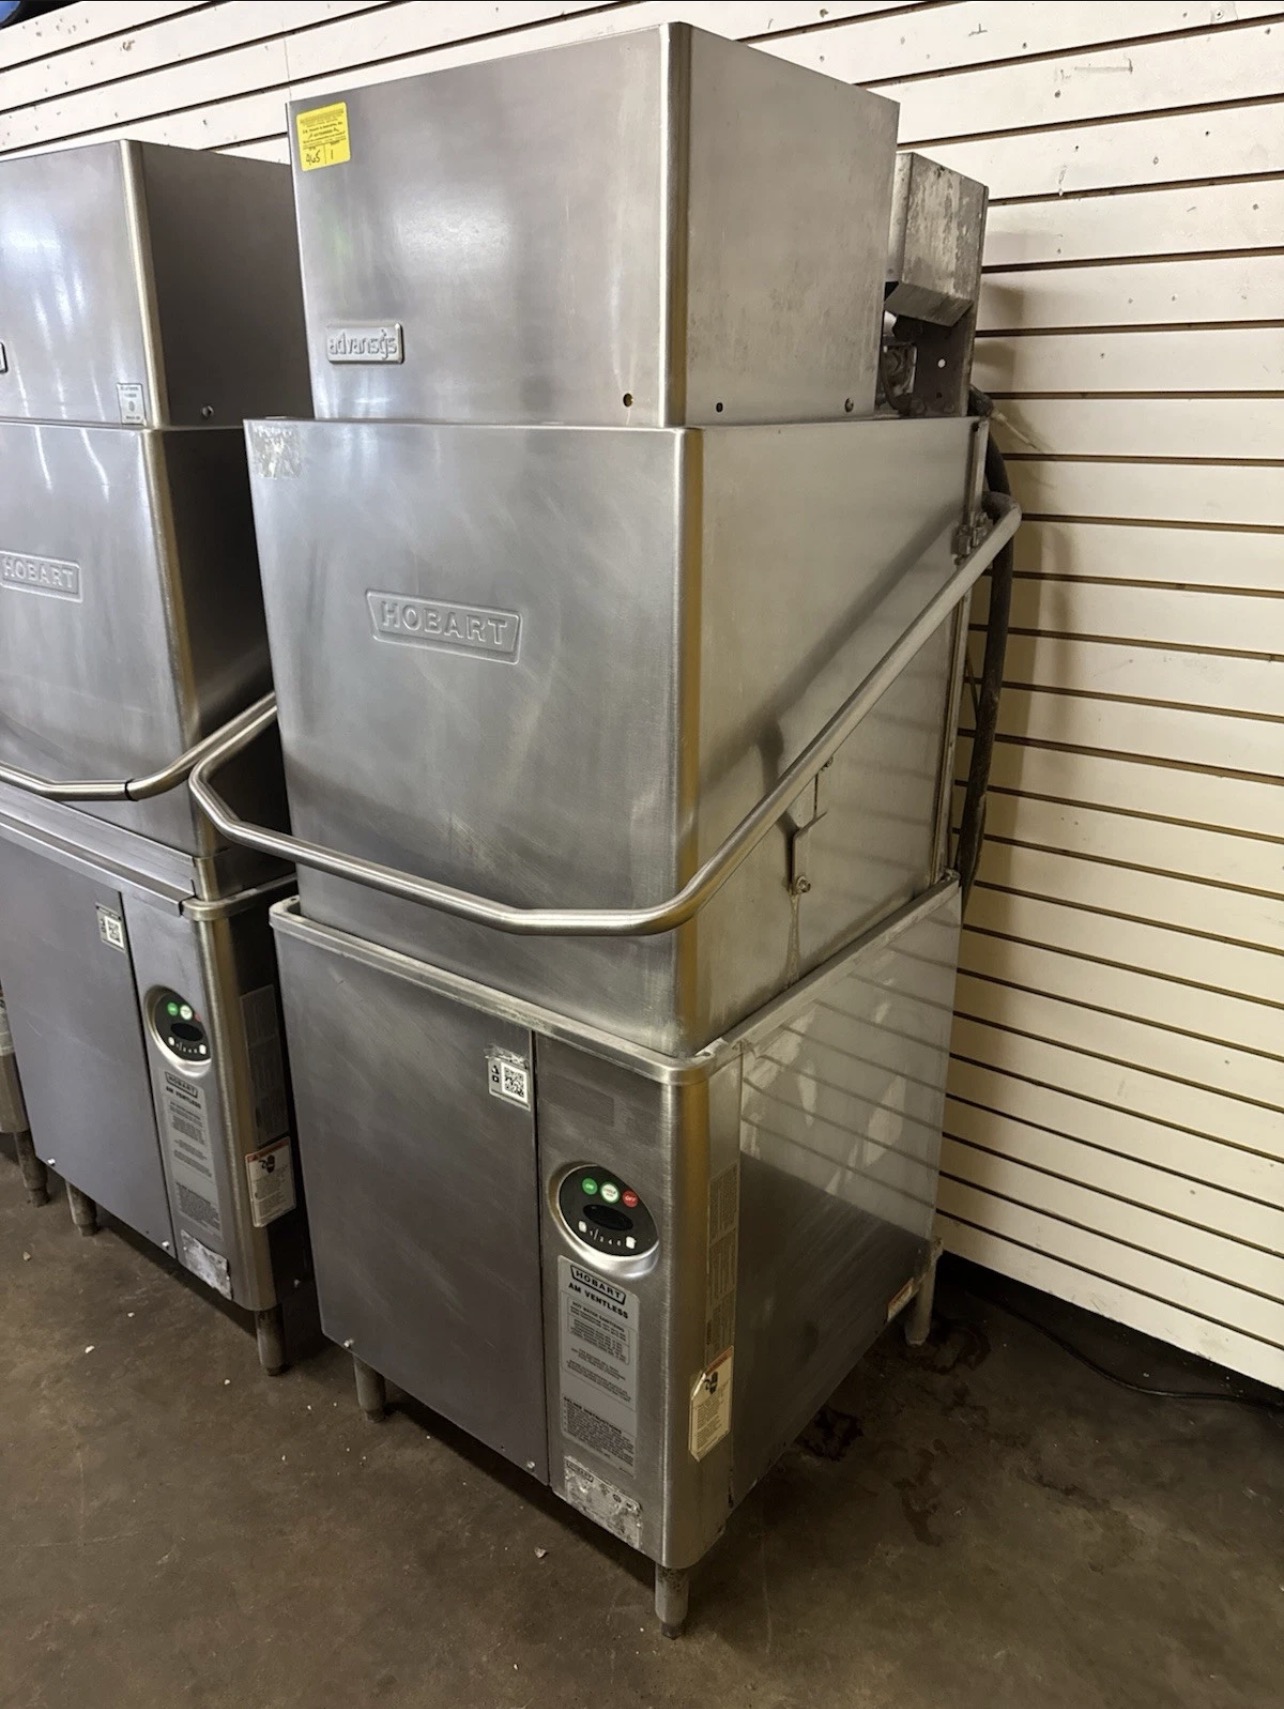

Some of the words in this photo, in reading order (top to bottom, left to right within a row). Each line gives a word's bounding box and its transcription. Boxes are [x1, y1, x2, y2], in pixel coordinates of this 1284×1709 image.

[329, 328, 398, 361] advansys
[3, 555, 74, 589] HOBART
[381, 600, 508, 645] HOBART
[568, 1282, 582, 1294] AM
[584, 1289, 629, 1320] VENTLESS
[575, 1269, 622, 1299] HOBART
